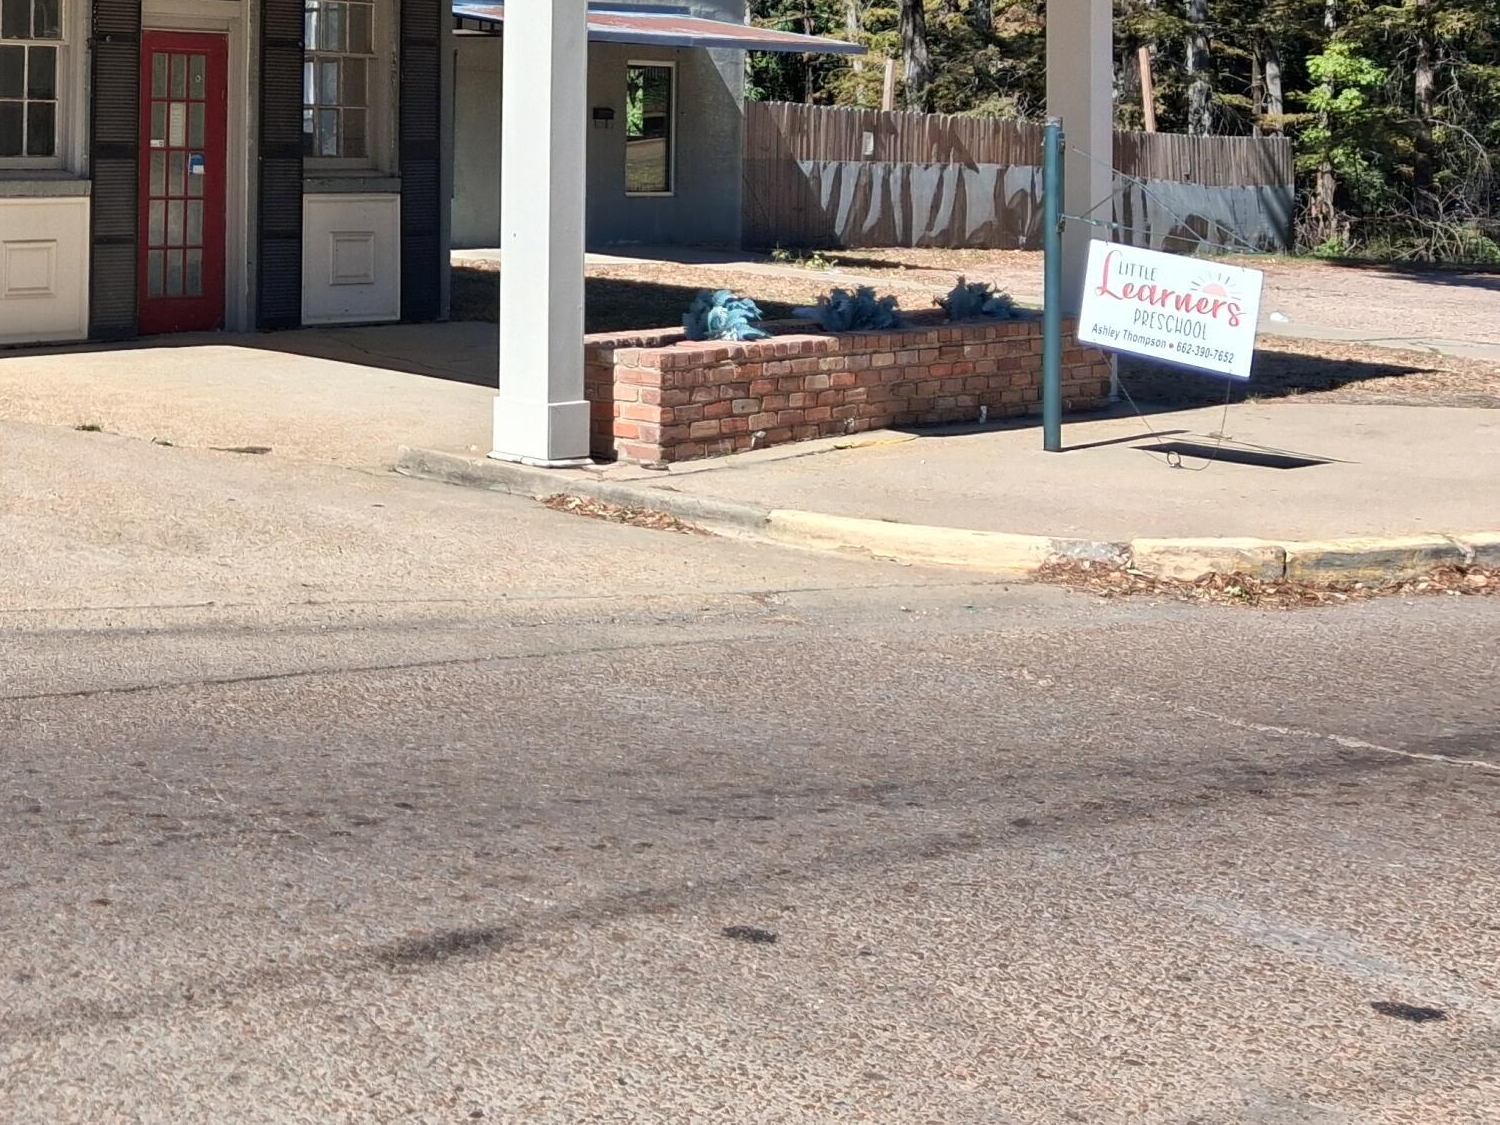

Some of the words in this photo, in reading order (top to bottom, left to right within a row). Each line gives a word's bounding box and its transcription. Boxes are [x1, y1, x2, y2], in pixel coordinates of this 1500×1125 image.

[1095, 249, 1247, 327] Learners
[1118, 260, 1157, 281] LITTLE
[1134, 308, 1206, 341] PRESCHOOL
[1092, 323, 1121, 341] Ashley
[1123, 329, 1167, 349] Thompson
[1177, 341, 1234, 364] 662-390-7652
